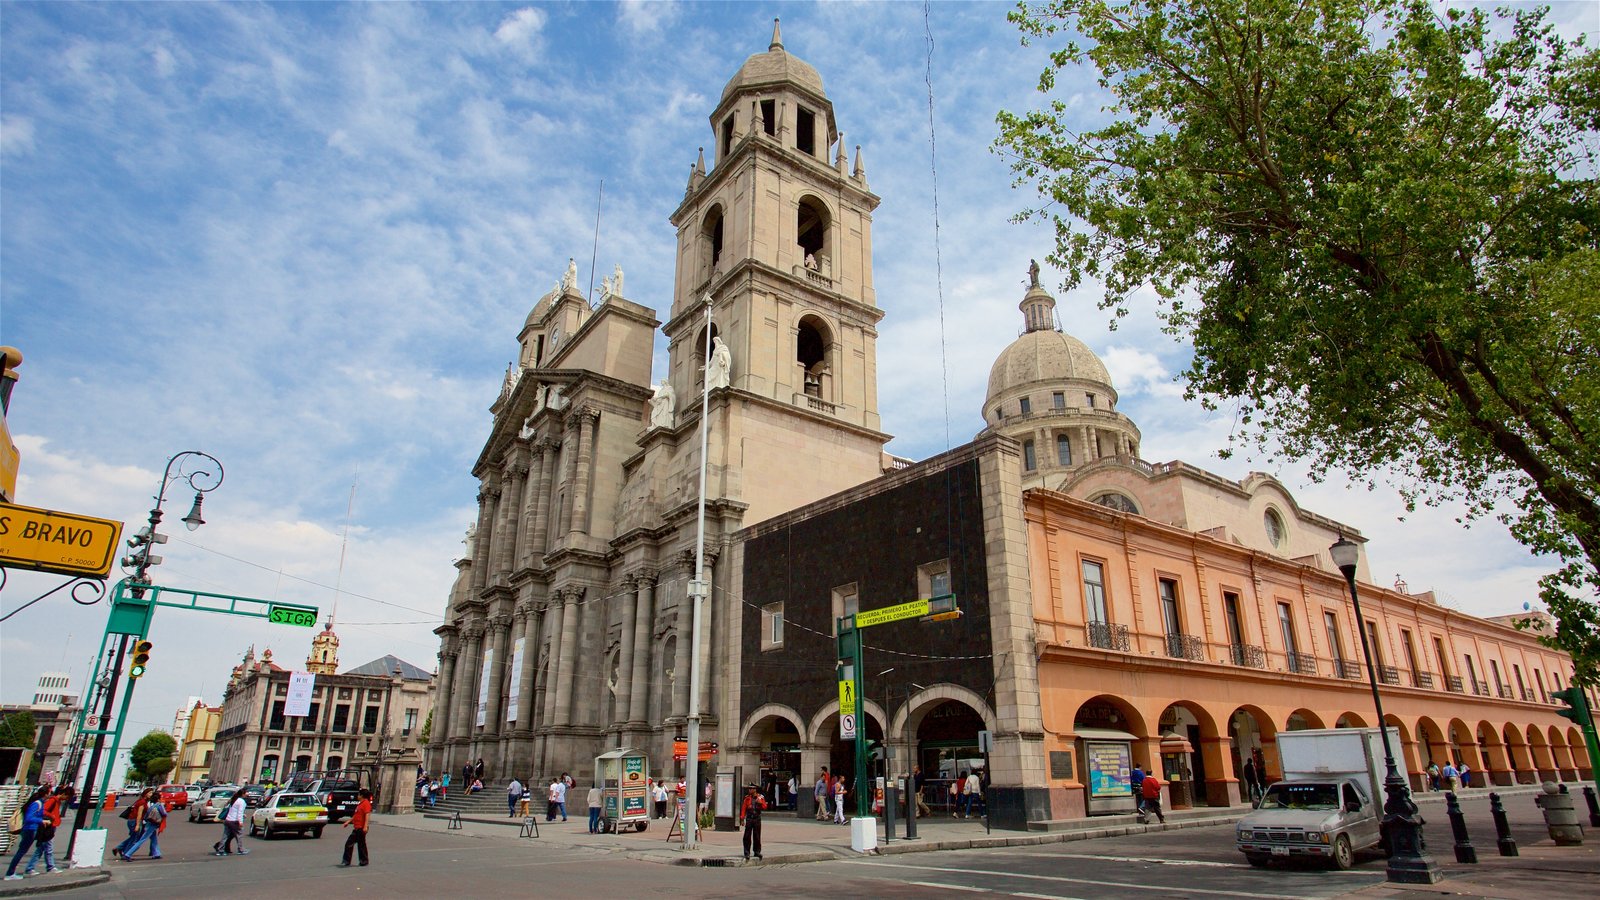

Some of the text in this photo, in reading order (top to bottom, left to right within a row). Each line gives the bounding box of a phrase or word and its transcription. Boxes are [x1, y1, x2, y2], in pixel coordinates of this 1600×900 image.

[22, 520, 93, 547] BRAVO
[75, 558, 96, 567] 50000
[882, 606, 902, 616] PRIMERO
[893, 608, 922, 618] CONDUCTOR
[272, 610, 313, 625] SIGA
